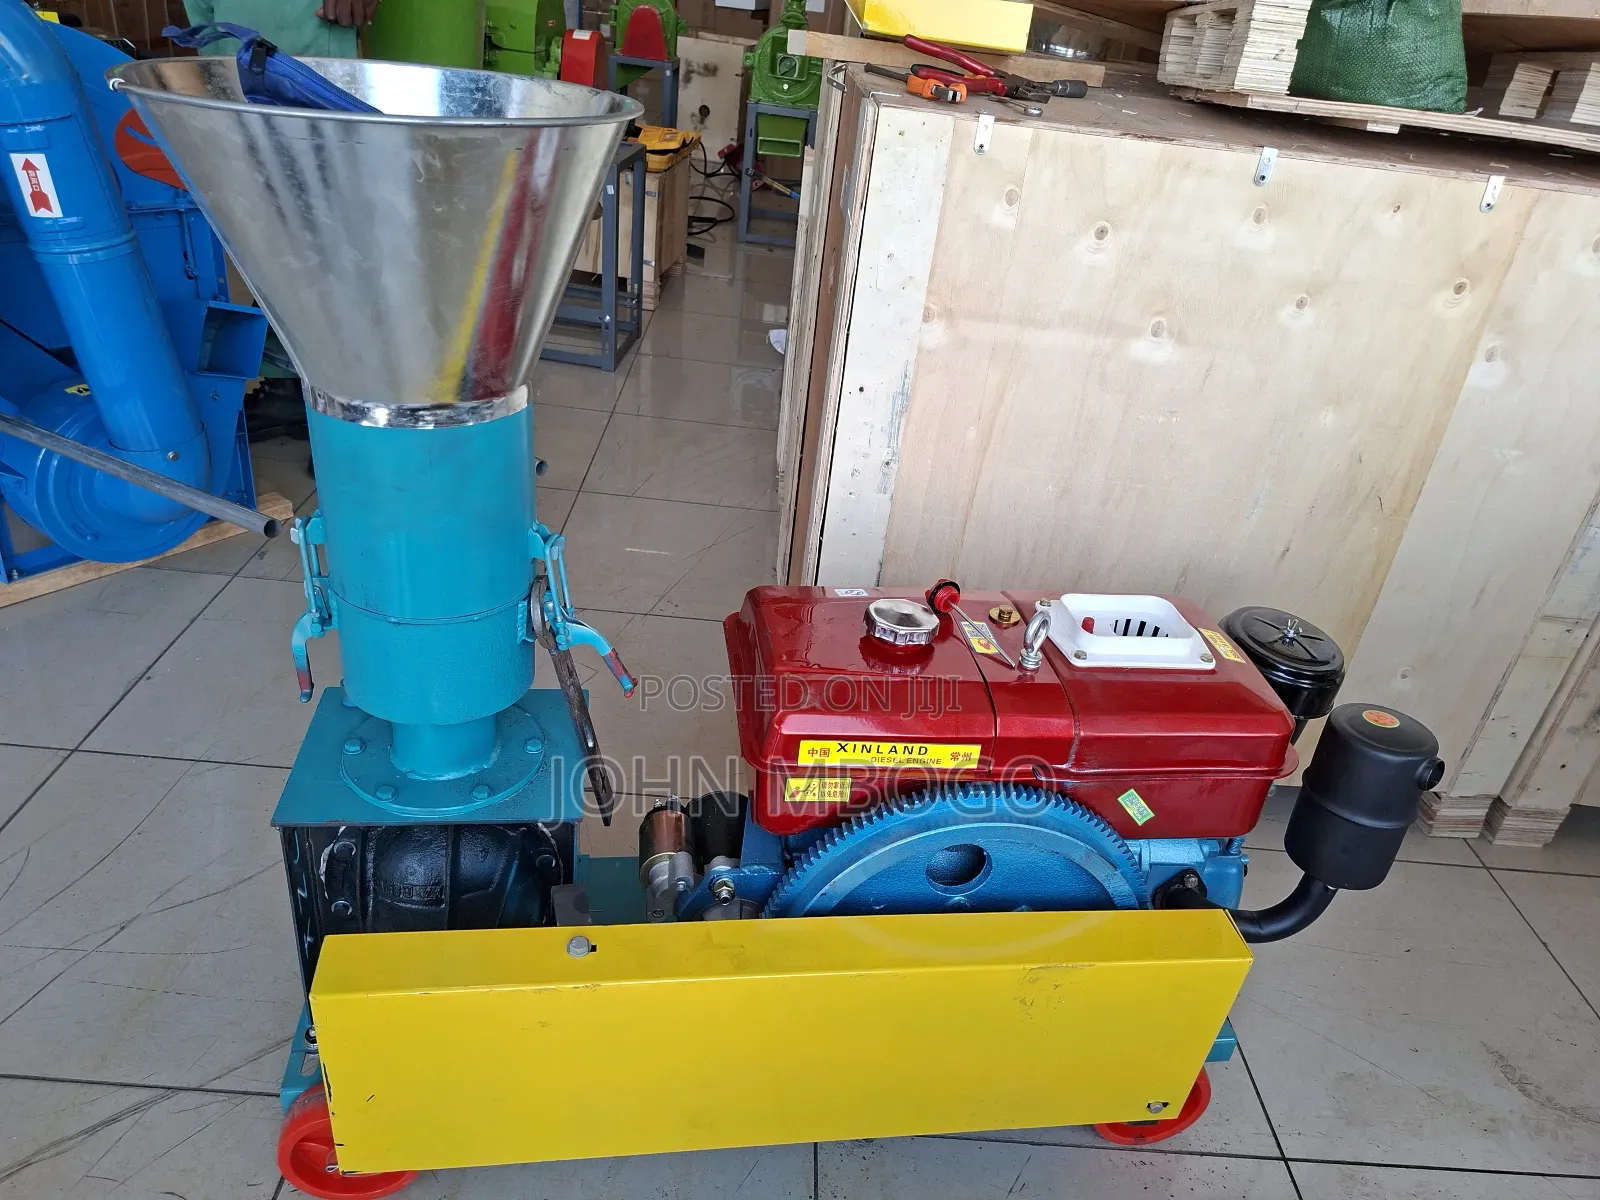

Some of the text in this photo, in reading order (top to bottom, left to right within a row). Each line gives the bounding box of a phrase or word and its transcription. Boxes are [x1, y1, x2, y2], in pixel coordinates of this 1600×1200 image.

[807, 747, 831, 758] 中国
[836, 742, 928, 756] XINLAND
[950, 751, 972, 762] 常州
